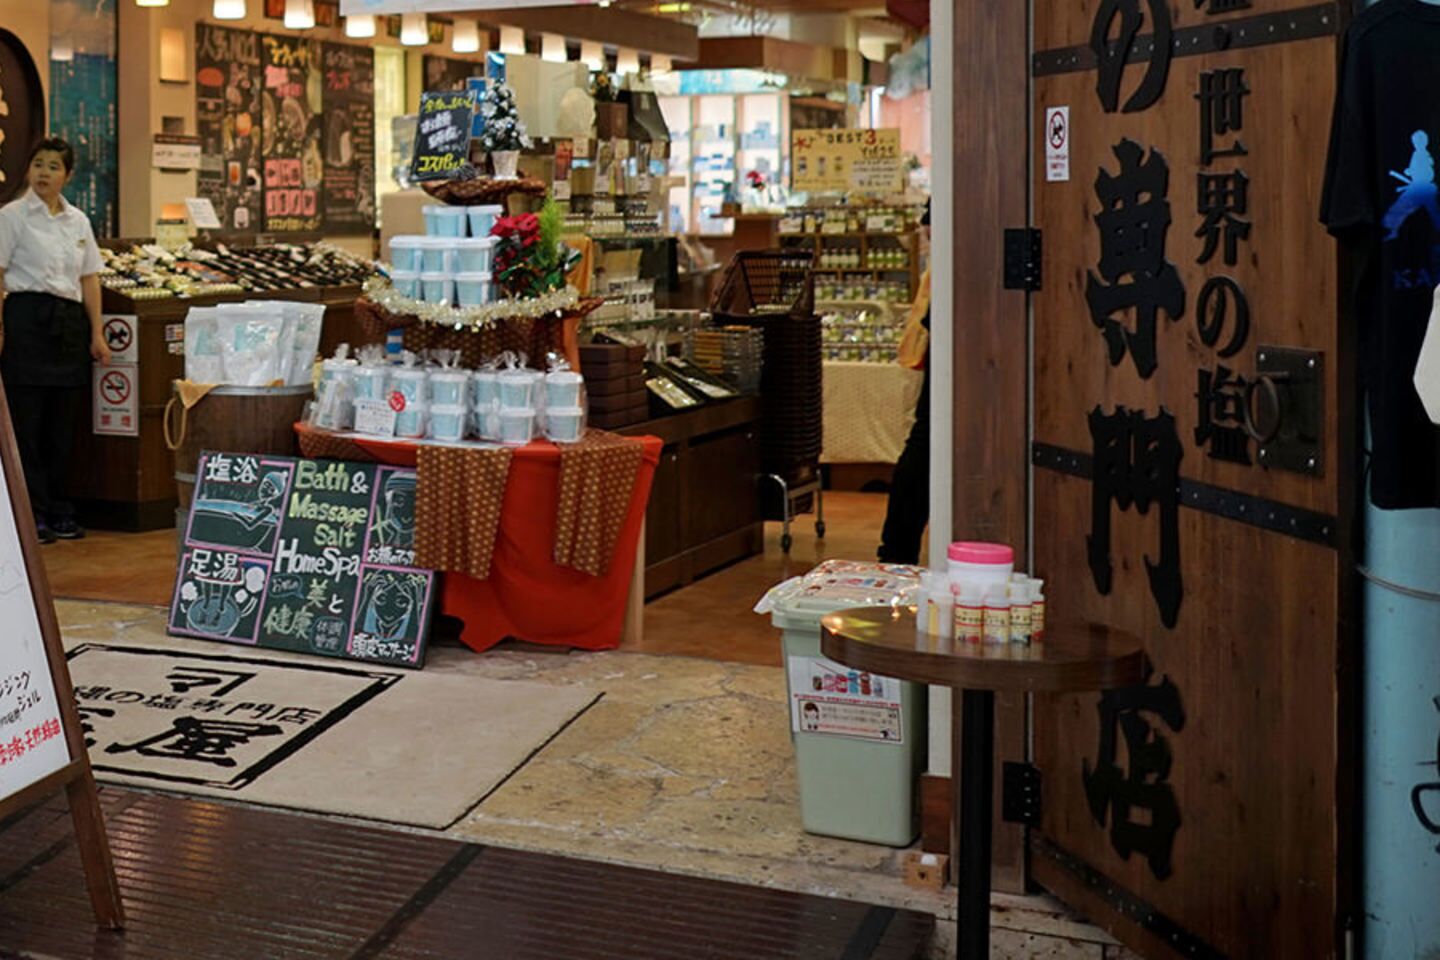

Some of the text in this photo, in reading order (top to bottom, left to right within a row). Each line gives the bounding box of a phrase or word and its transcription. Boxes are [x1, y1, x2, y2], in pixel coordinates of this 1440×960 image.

[205, 453, 258, 483] 塩浴
[295, 460, 369, 494] Bath &
[288, 492, 369, 524] Massage
[313, 523, 357, 547] Salt
[190, 549, 238, 581] 足湯
[275, 538, 360, 583] HomeSpa
[264, 603, 314, 640] 健康
